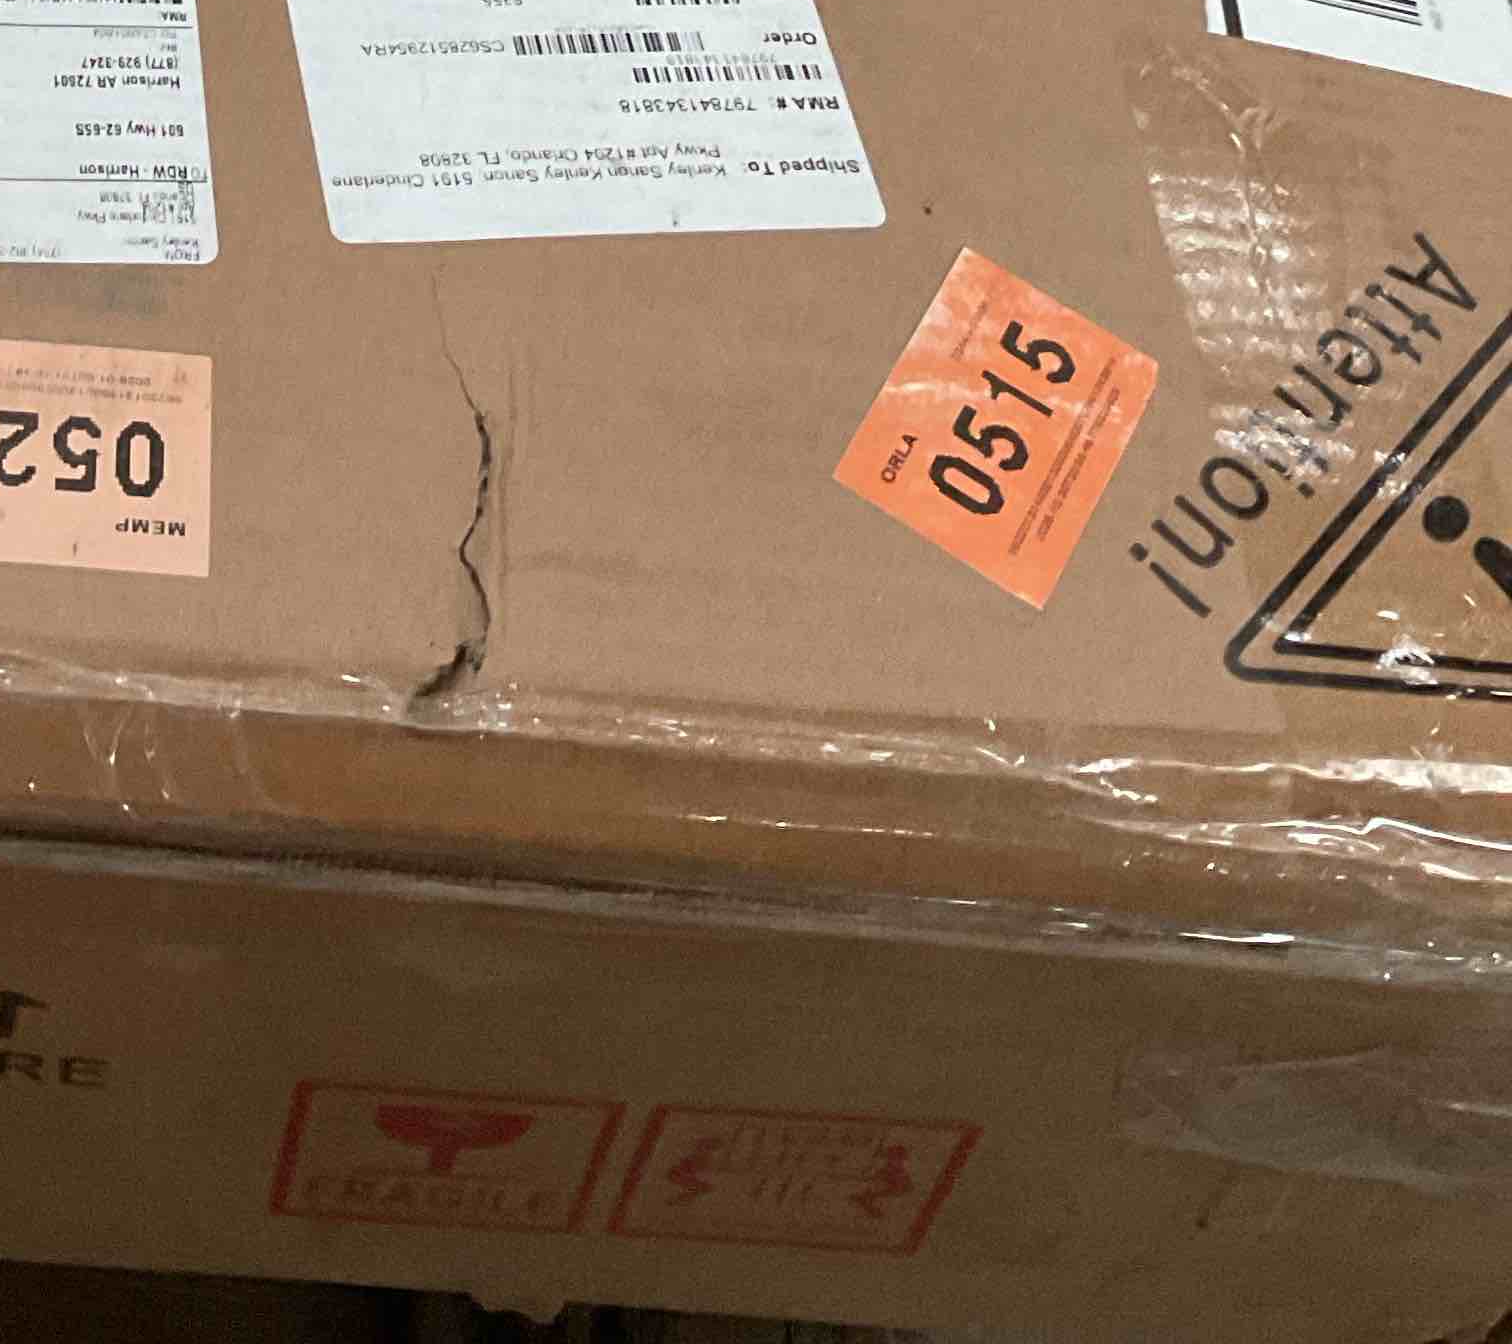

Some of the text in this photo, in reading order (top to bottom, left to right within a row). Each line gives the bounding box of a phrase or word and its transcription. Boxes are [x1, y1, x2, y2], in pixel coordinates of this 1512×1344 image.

[763, 31, 817, 46] Order
[81, 55, 179, 70] (877) 929-3247
[53, 75, 180, 89] Harrison AR 72601
[619, 97, 757, 112] 797841343818
[792, 96, 839, 111] RMA
[127, 120, 156, 137] Hwy
[477, 152, 501, 165] FL
[641, 145, 669, 159] Apt
[676, 143, 721, 159] Pkwy
[79, 164, 139, 179] Harrison
[153, 165, 187, 180] RDW
[545, 166, 603, 182] Kenley
[668, 162, 726, 179] Kenley
[780, 157, 860, 176] Shipped
[332, 173, 425, 191] Cinderlane
[432, 172, 473, 187] 5191
[928, 319, 1077, 516] 0515
[880, 433, 919, 485] ORLA
[115, 517, 186, 537] MEMP
